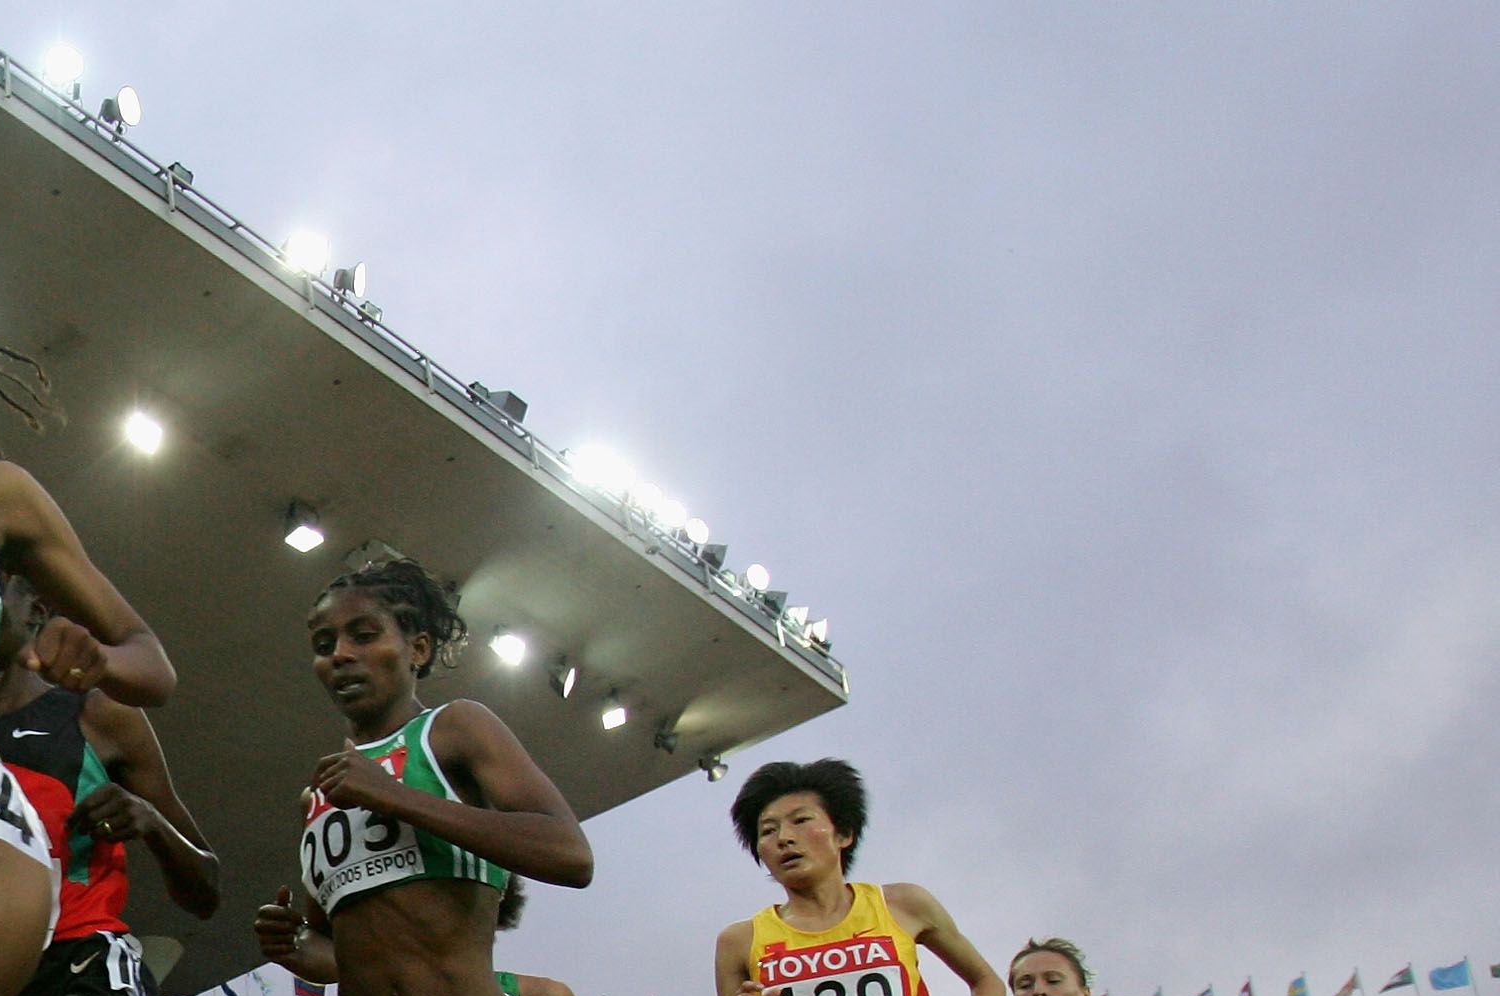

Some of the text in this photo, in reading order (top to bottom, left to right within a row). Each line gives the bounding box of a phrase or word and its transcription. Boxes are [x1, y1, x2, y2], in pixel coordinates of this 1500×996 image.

[305, 810, 401, 891] 203
[366, 850, 417, 878] ESPOO
[763, 942, 891, 982] TOYOTA
